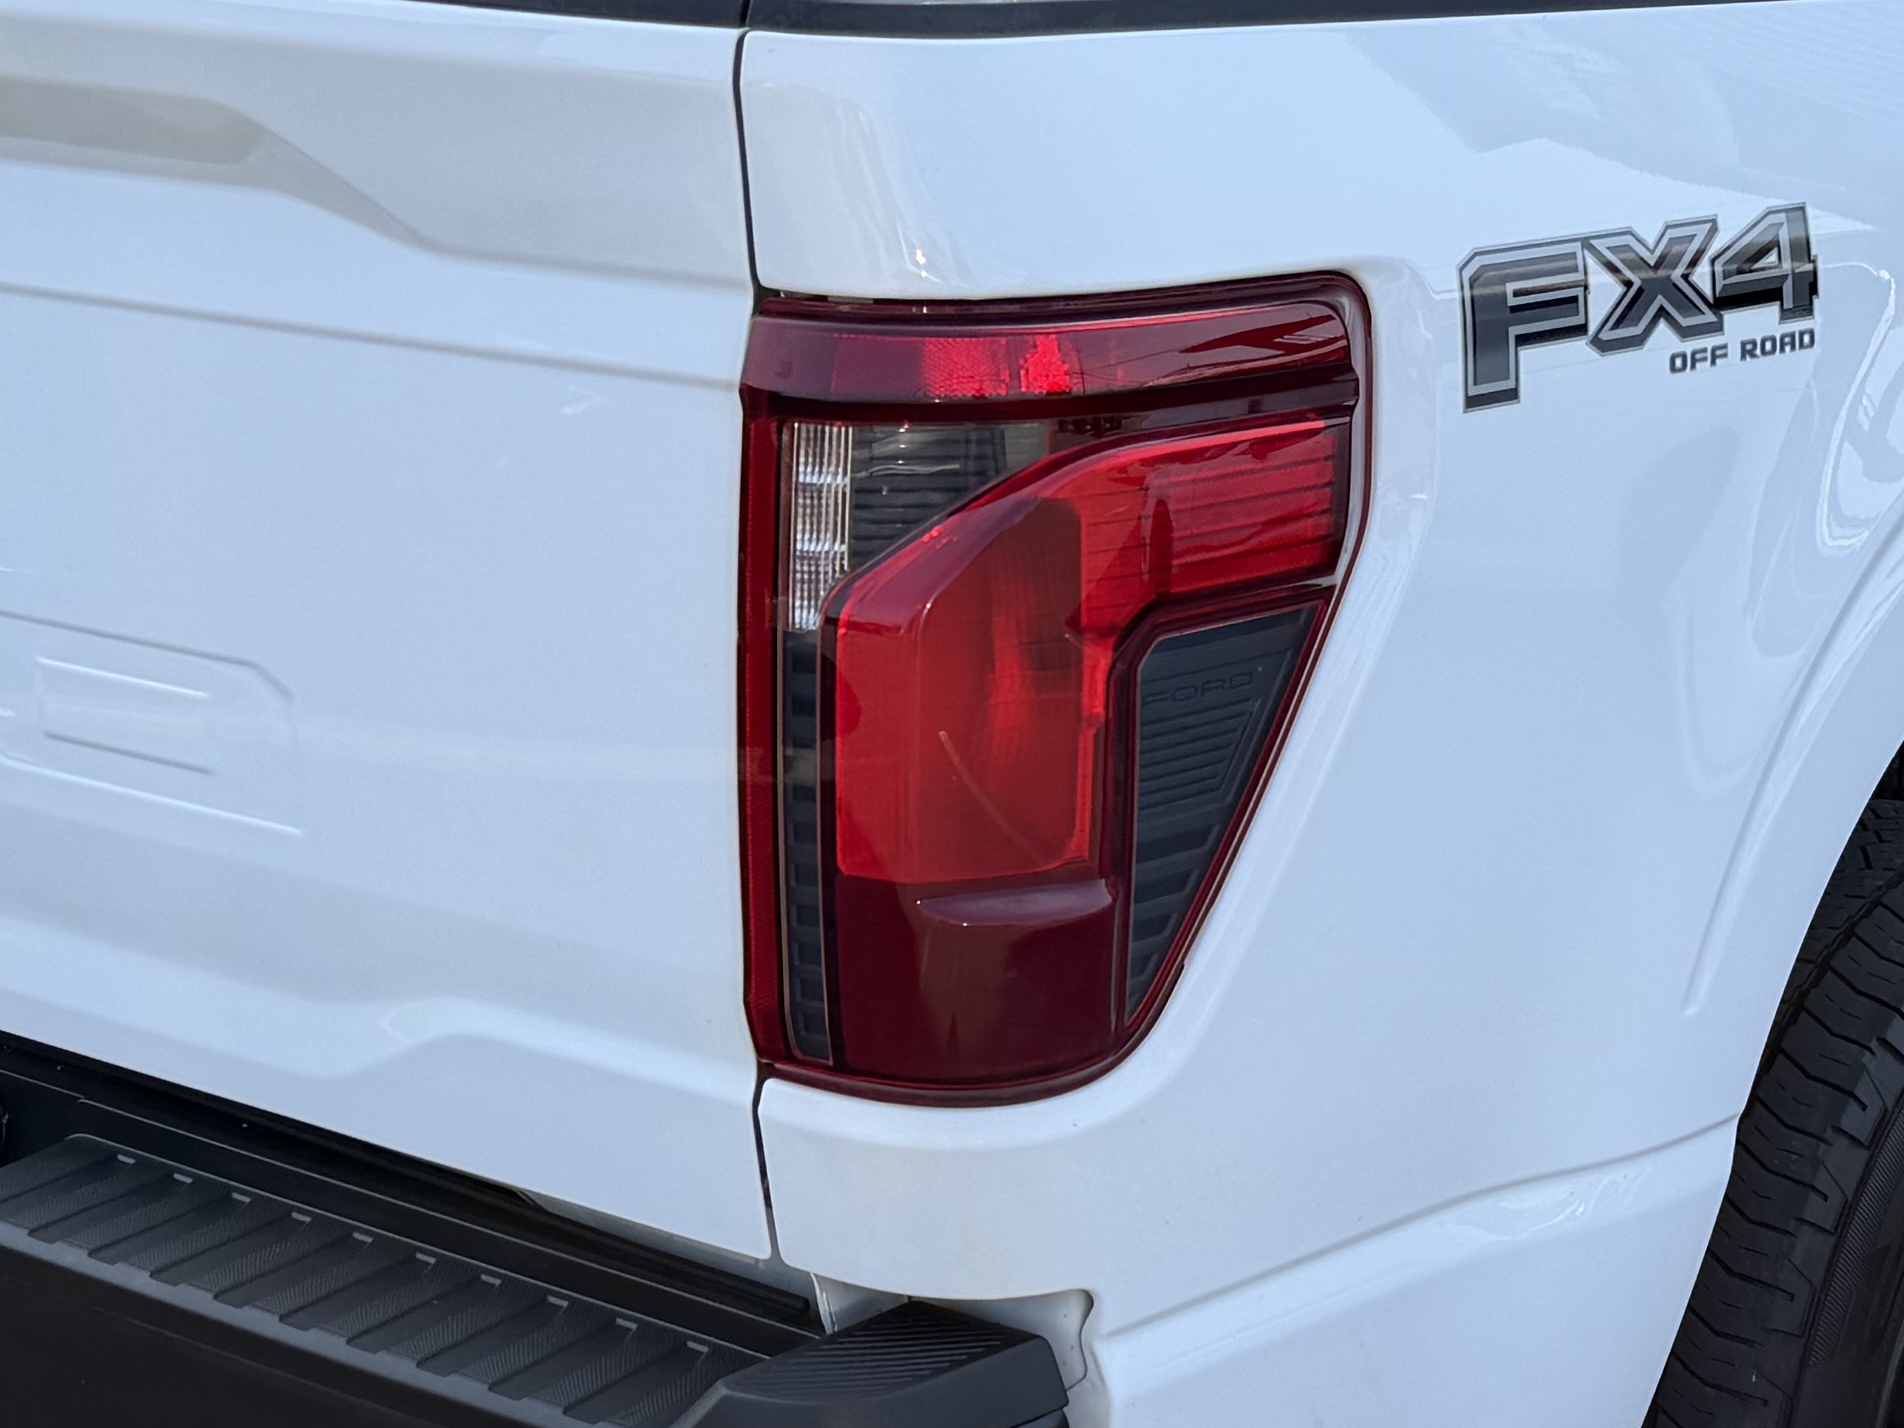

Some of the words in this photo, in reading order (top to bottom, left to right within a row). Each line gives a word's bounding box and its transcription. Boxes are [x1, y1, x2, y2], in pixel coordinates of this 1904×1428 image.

[1456, 202, 1819, 413] FX4
[1669, 342, 1729, 373] OFF
[1740, 328, 1816, 362] ROAD
[1142, 670, 1254, 705] FORD
